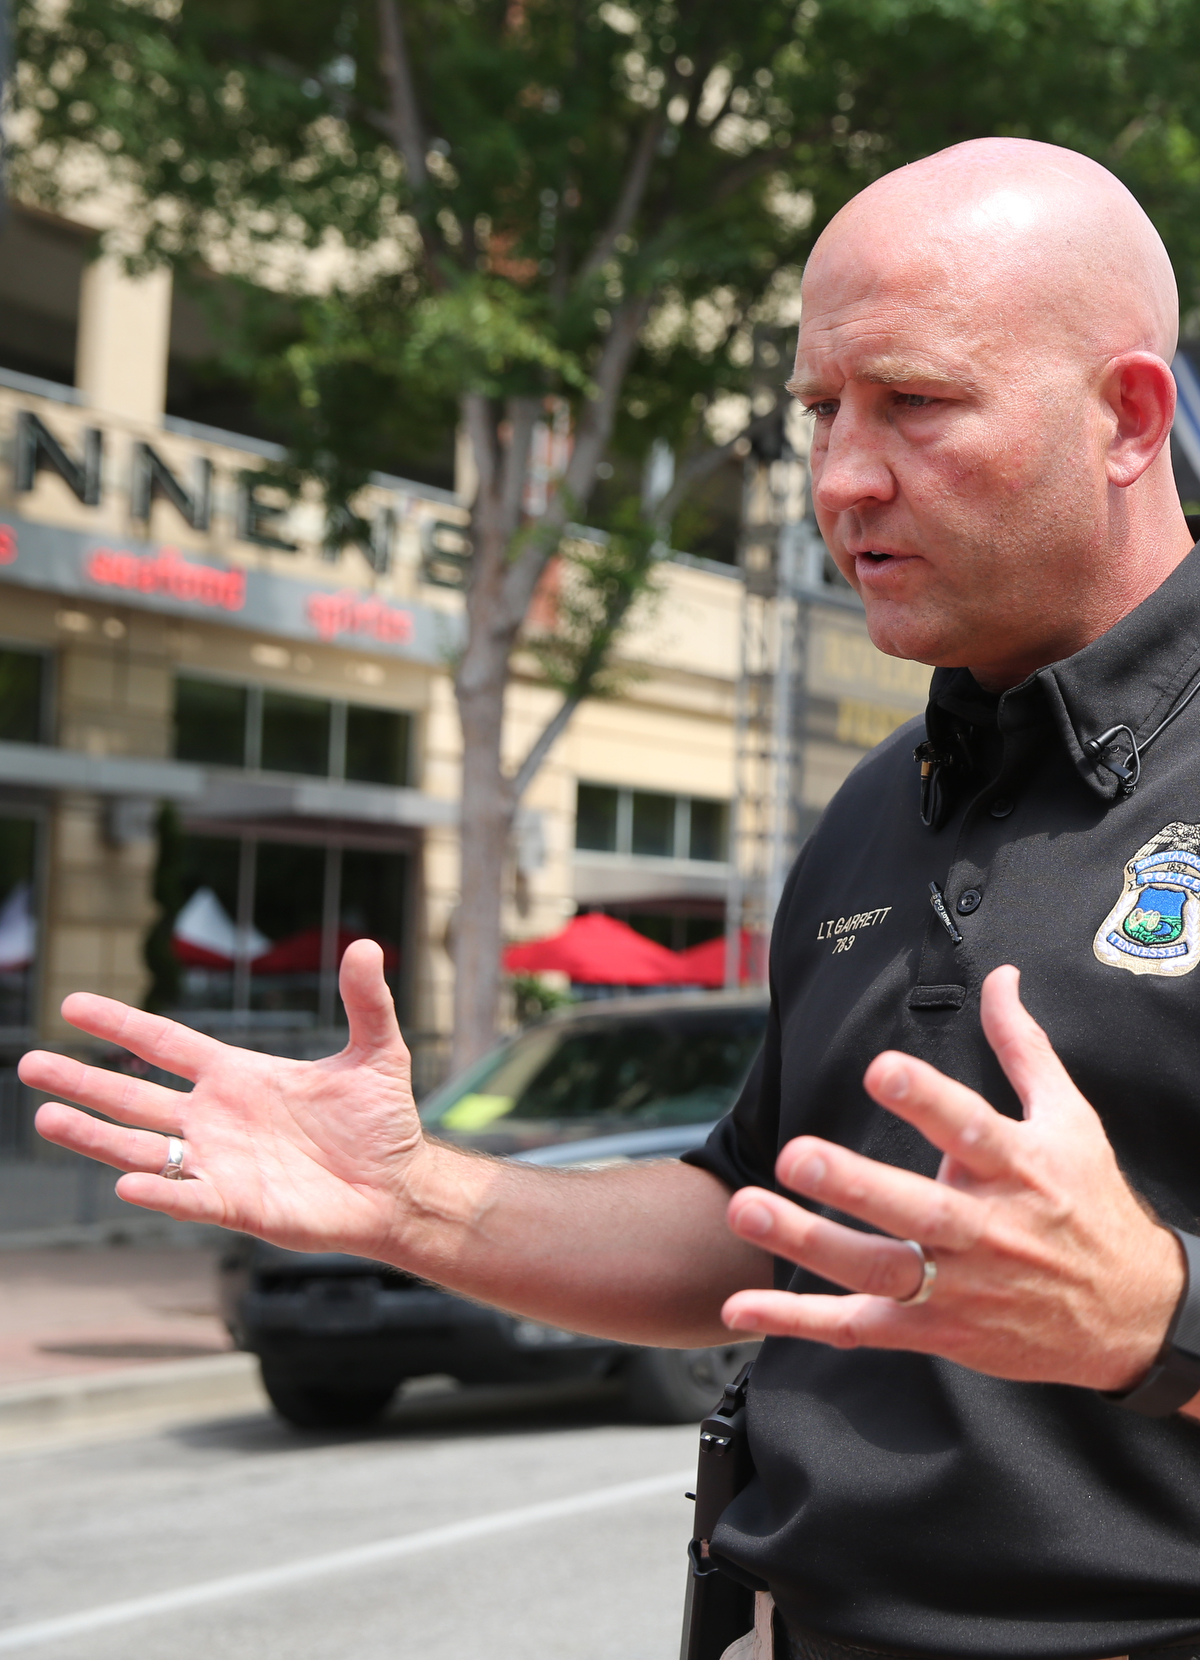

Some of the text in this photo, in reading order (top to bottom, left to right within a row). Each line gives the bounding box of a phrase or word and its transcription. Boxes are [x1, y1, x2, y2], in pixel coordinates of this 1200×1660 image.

[1166, 862, 1187, 873] 1852
[1142, 871, 1200, 889] POLICE
[1110, 933, 1186, 957] TENNESSEE
